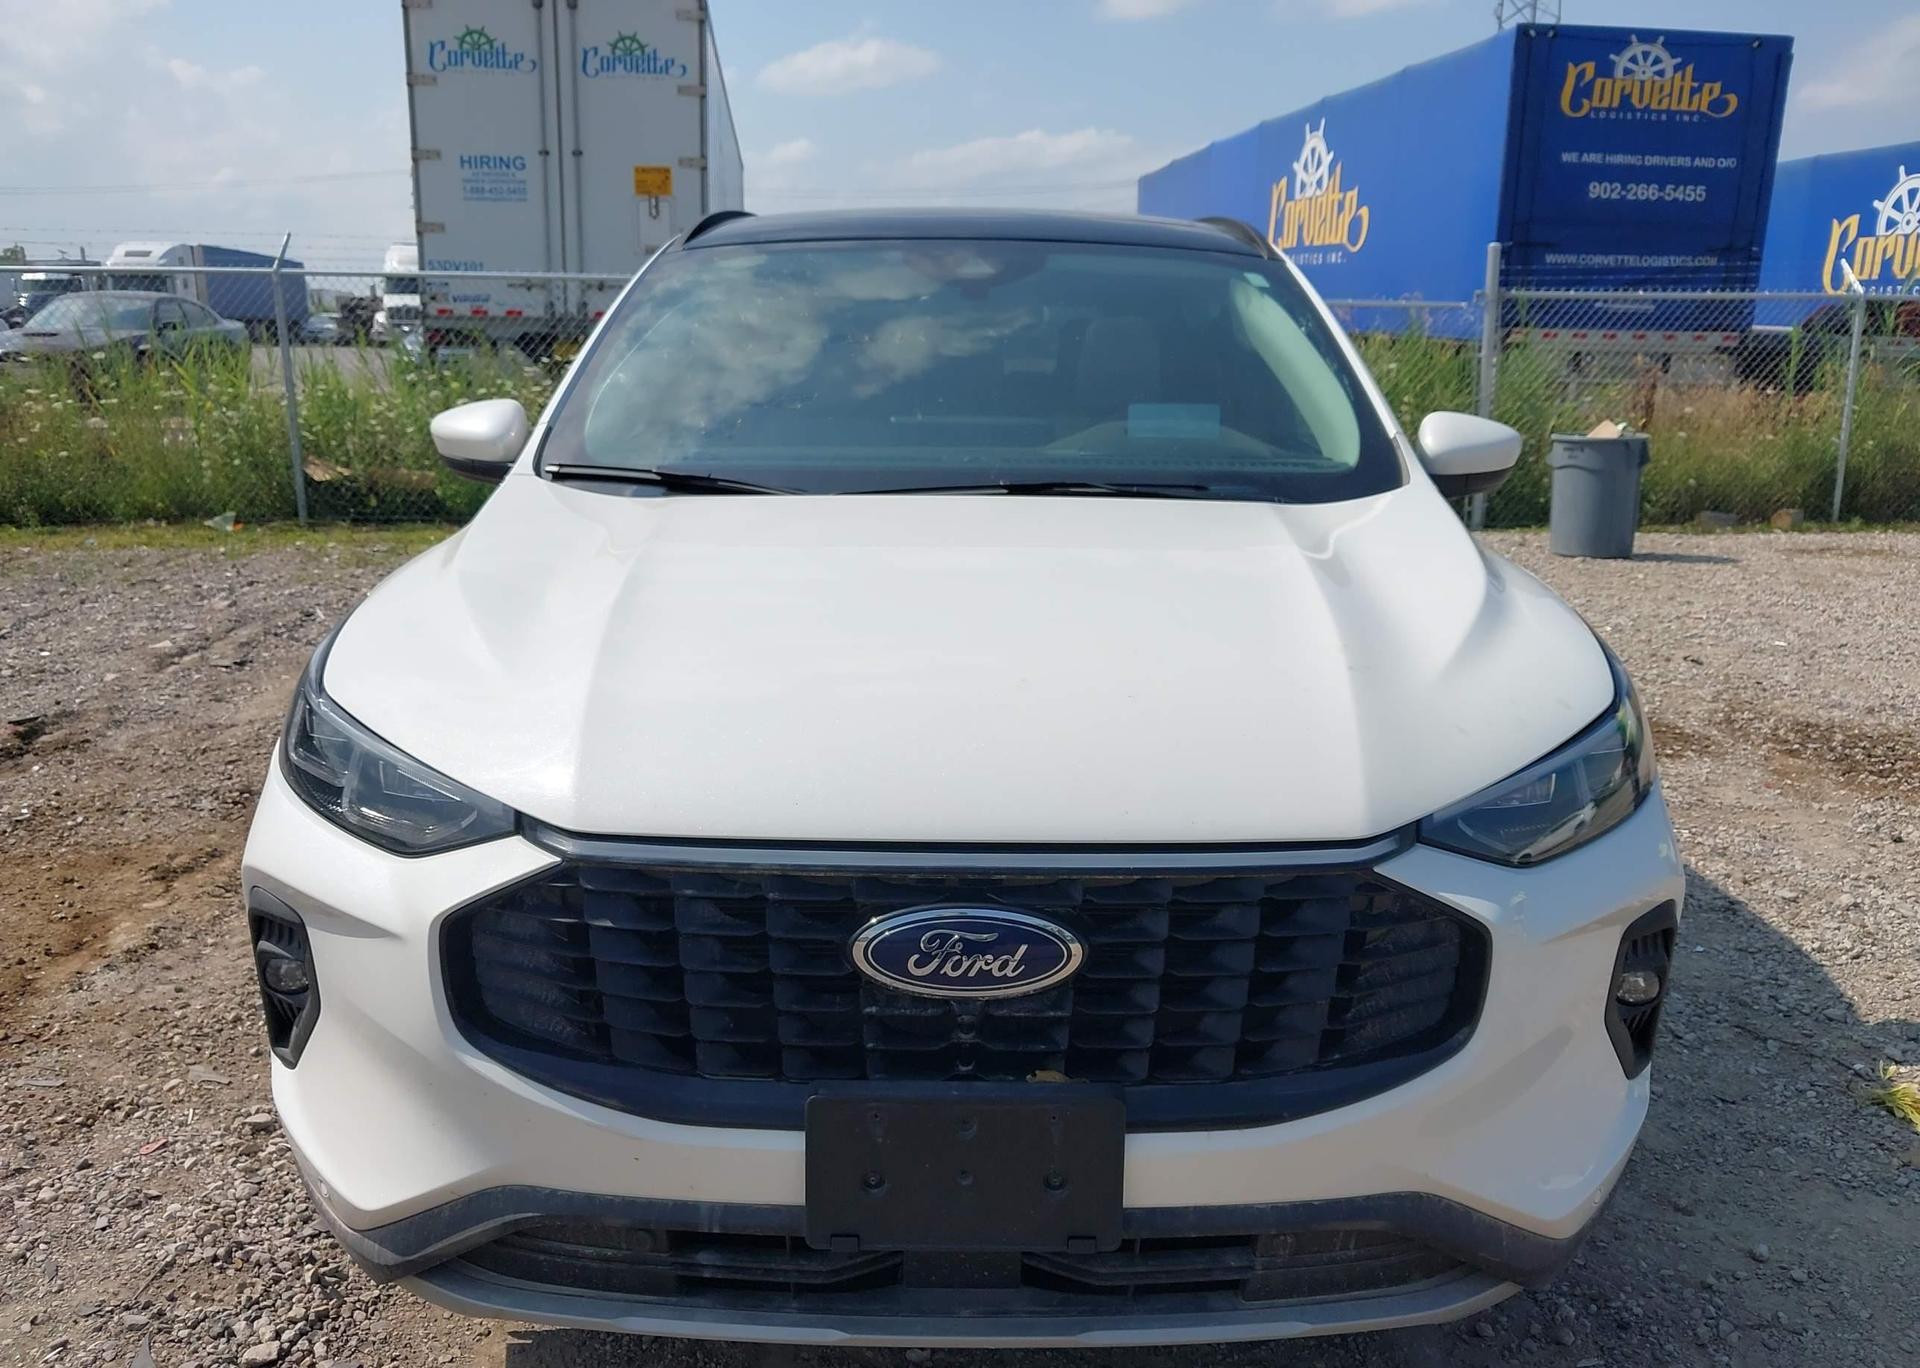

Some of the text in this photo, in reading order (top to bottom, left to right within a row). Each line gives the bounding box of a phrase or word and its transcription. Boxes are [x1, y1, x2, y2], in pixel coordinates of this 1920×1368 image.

[428, 40, 537, 73] Corvette
[581, 46, 688, 78] Corvette
[1560, 61, 1738, 118] Corvette
[1589, 110, 1668, 122] LOGISTICS
[459, 154, 527, 171] HIRING
[1561, 151, 1579, 163] WE
[1581, 152, 1604, 164] ARE
[1605, 154, 1643, 166] HIRING
[1644, 156, 1692, 167] DRIVERS
[1693, 157, 1715, 168] AND
[1267, 161, 1369, 252] Corvette
[1588, 181, 1707, 202] 902-266-5455
[907, 929, 1028, 978] Ford
